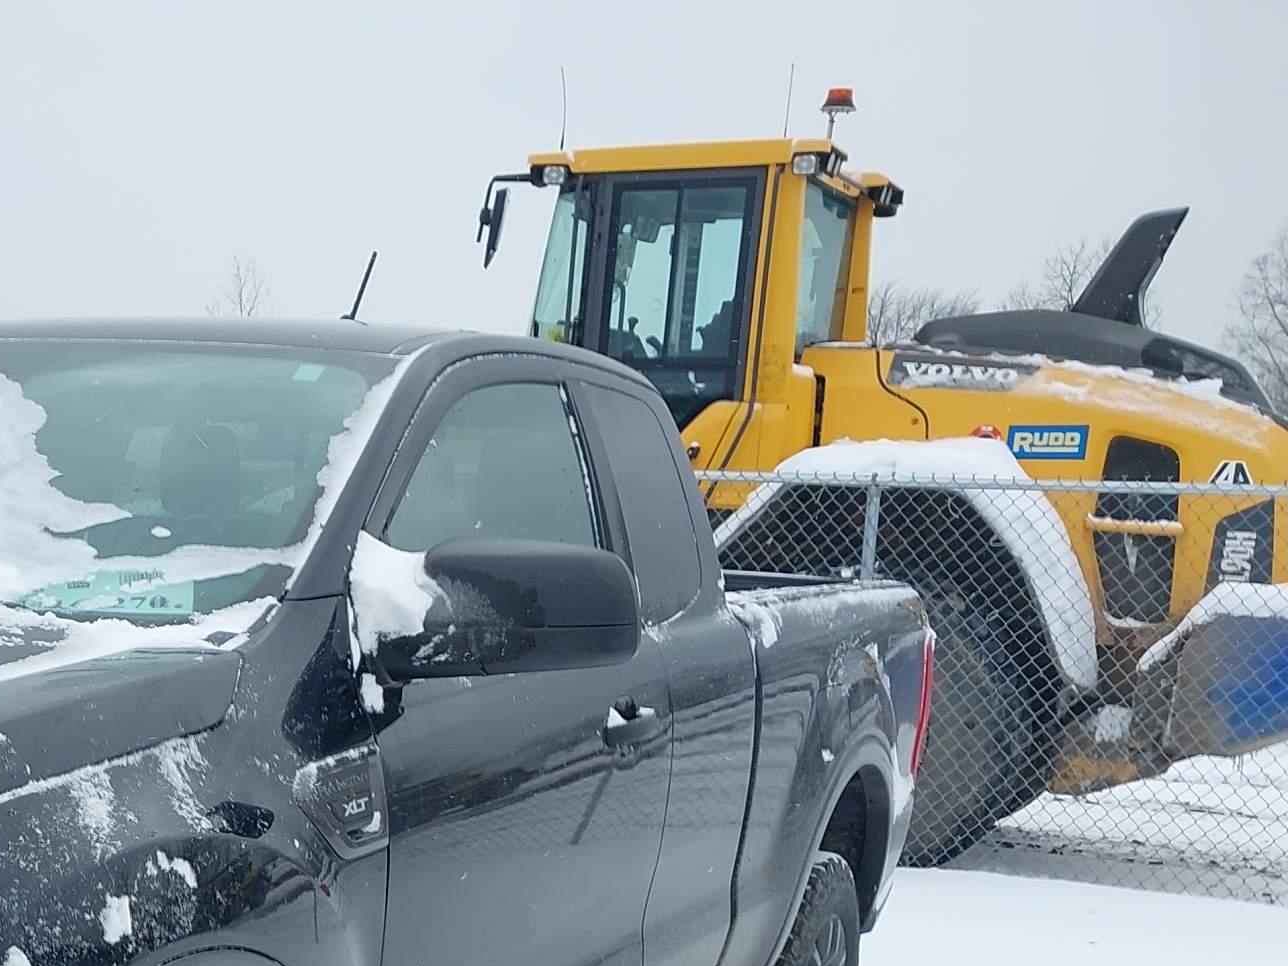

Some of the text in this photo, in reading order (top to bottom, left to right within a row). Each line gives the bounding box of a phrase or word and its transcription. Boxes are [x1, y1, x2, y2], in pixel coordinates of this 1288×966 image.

[902, 361, 1018, 384] VOLVO
[1013, 432, 1081, 452] RUDD
[342, 797, 369, 817] XLT
